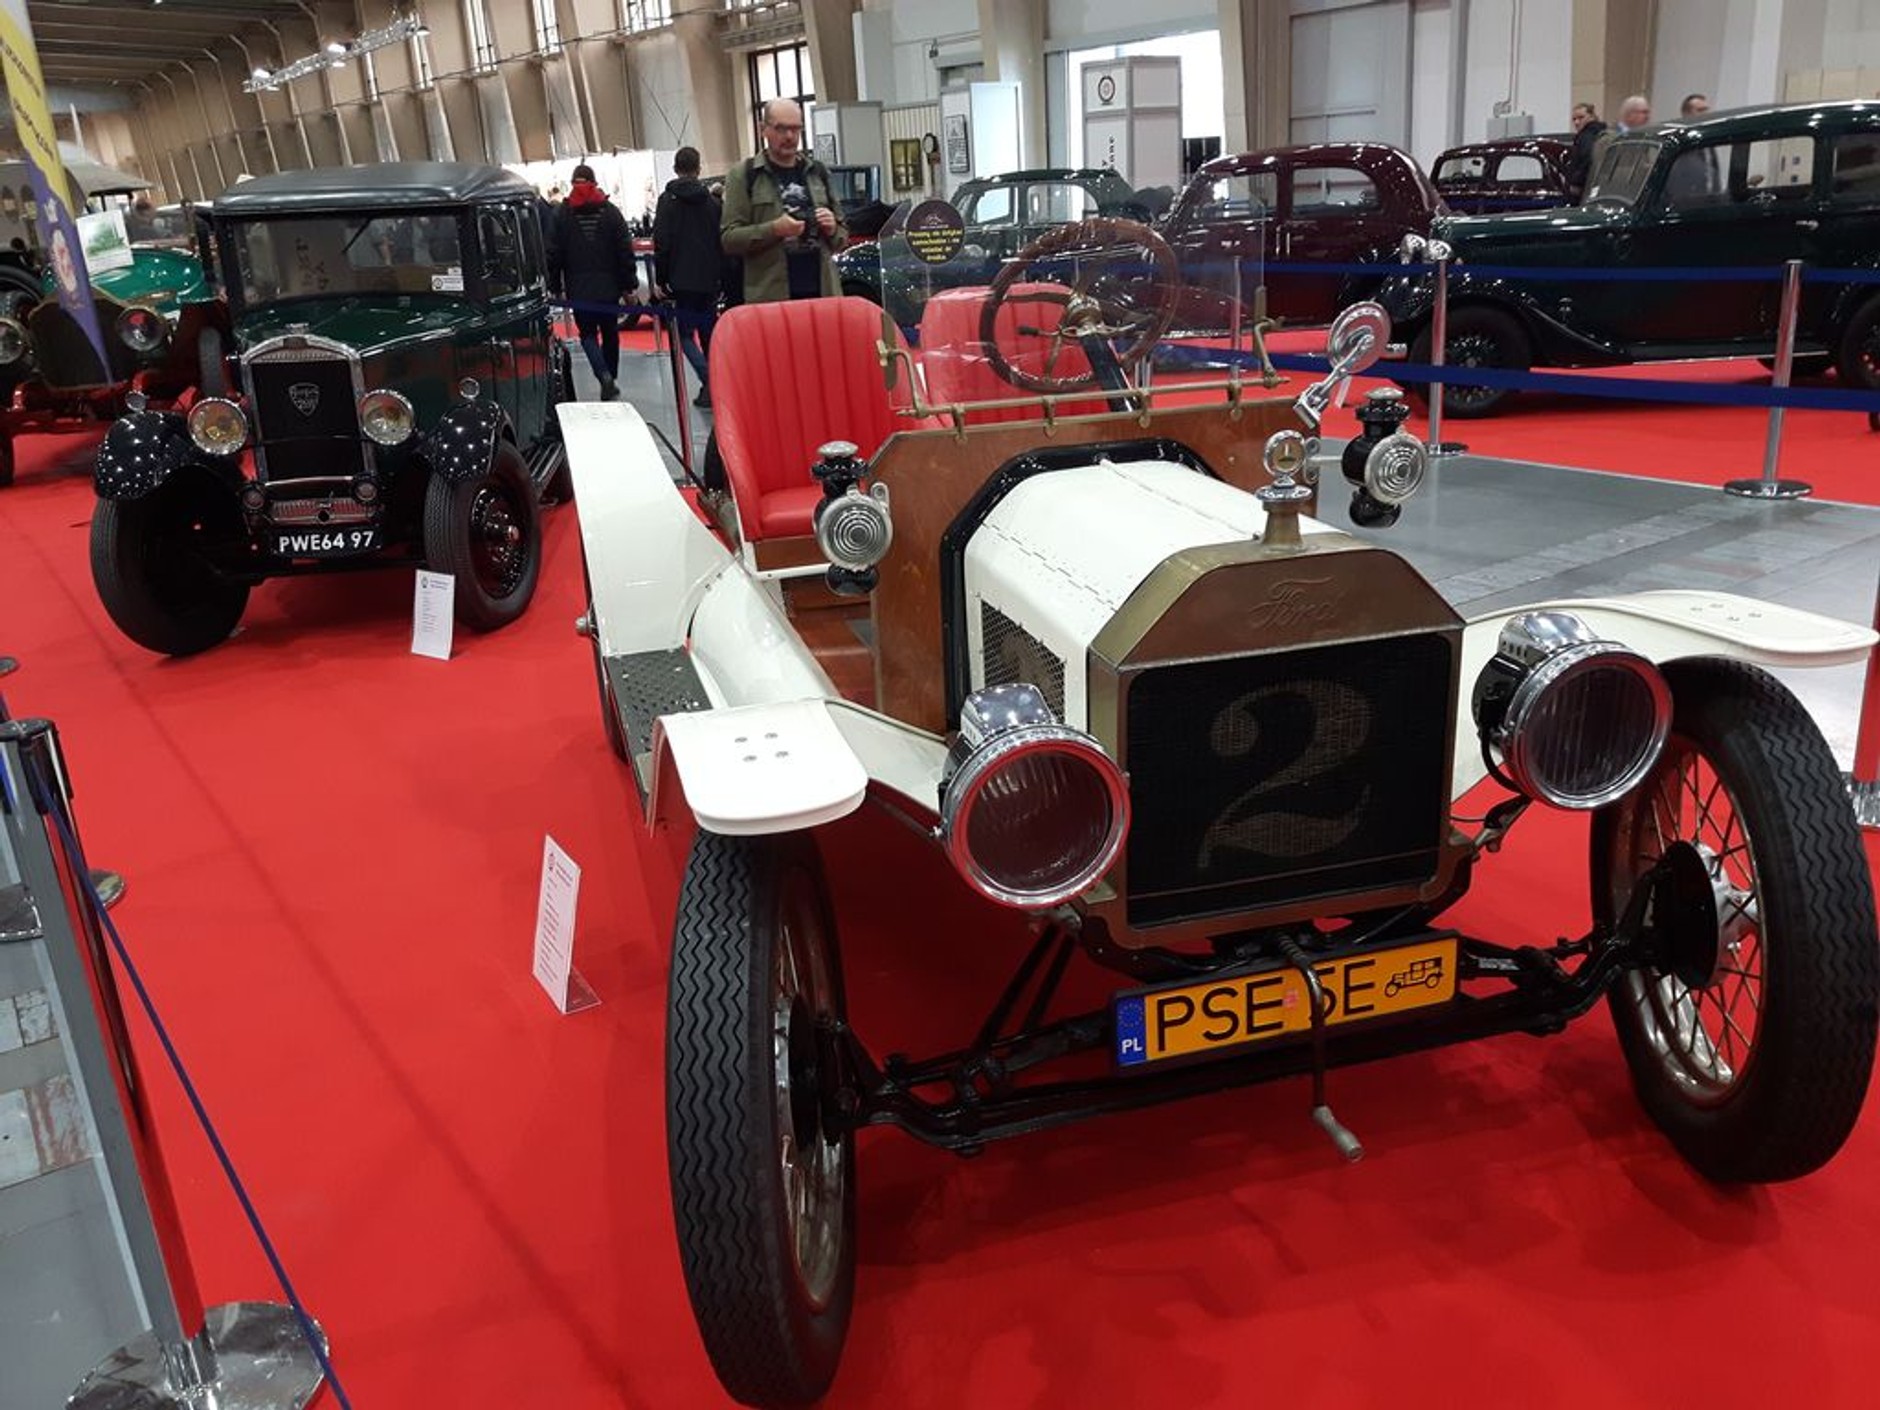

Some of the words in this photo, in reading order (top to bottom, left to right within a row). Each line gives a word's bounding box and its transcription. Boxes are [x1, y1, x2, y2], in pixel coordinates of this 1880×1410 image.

[350, 530, 374, 549] 97
[1247, 575, 1346, 631] Ford
[1198, 677, 1374, 869] 2
[1157, 976, 1284, 1053] PSE
[1121, 1038, 1143, 1054] PL
